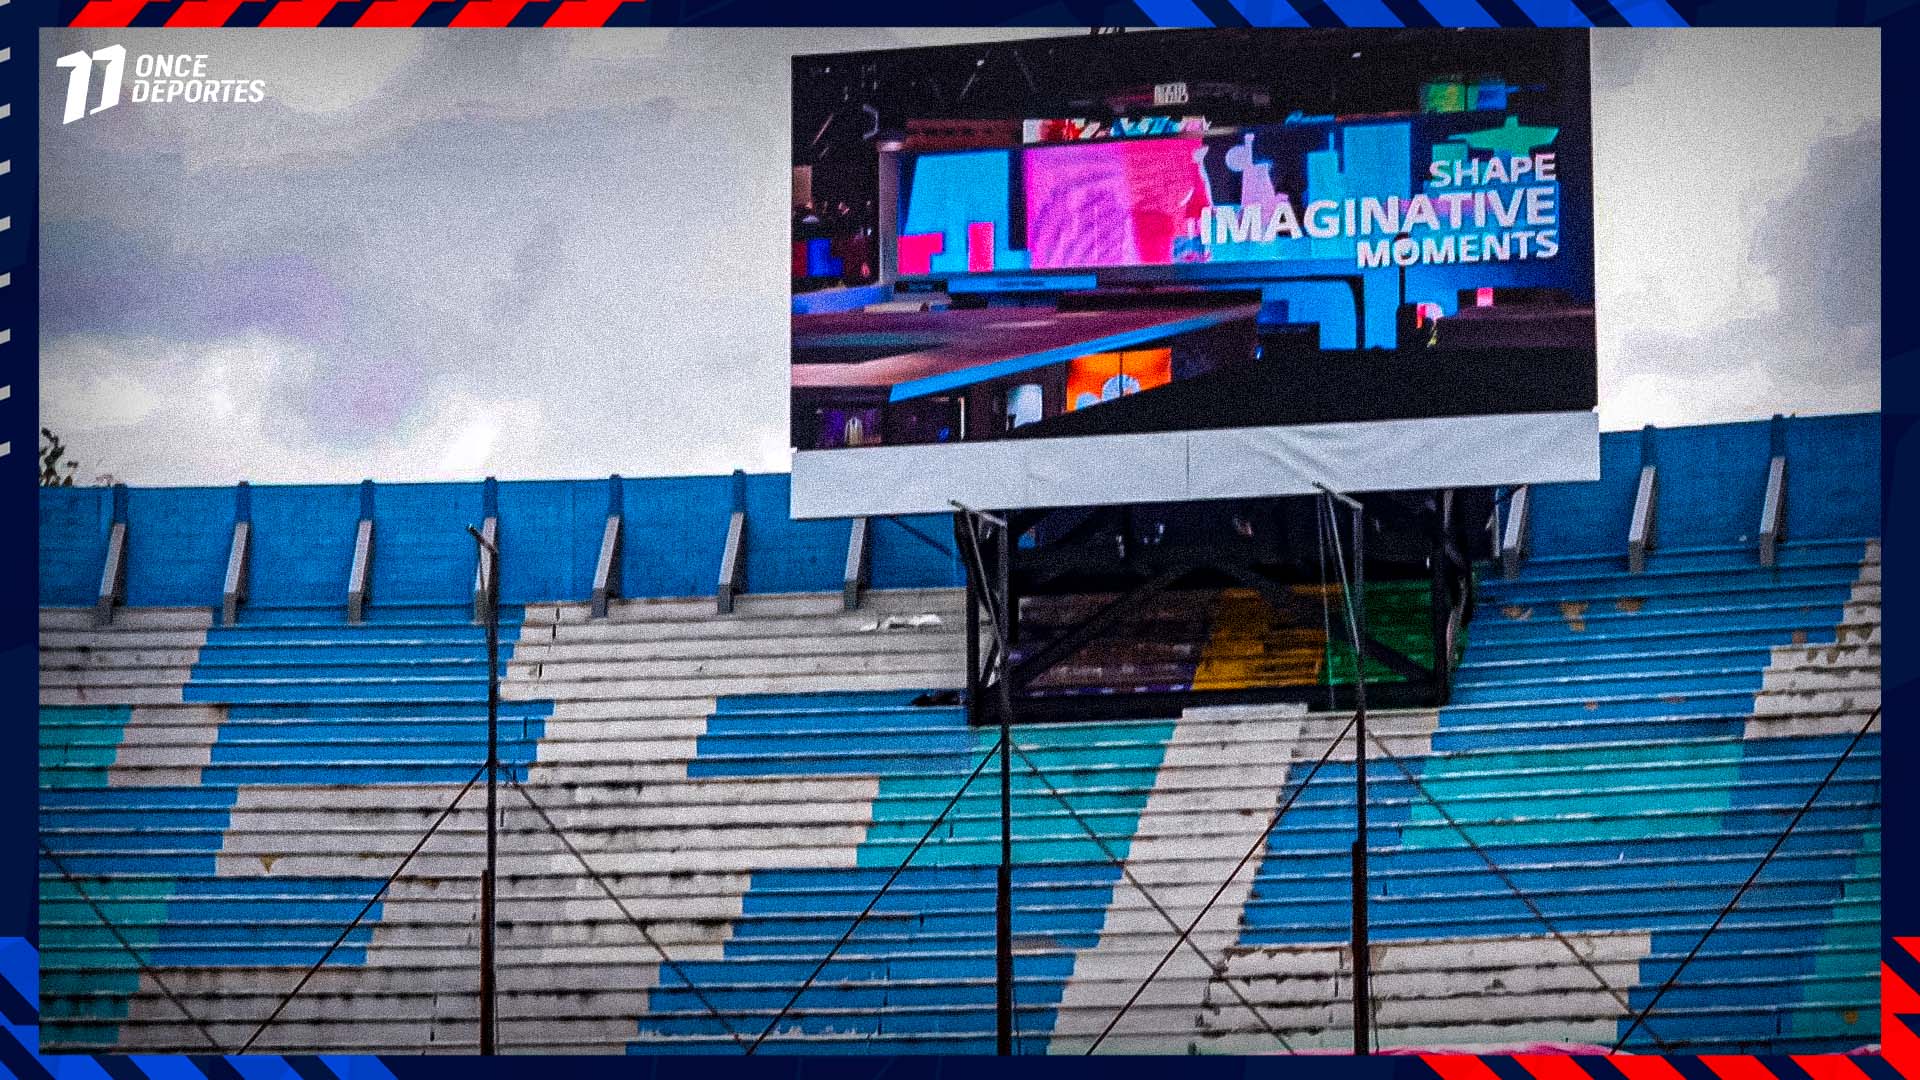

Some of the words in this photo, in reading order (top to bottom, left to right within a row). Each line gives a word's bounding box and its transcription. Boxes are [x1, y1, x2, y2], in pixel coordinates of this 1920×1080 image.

[1429, 153, 1557, 188] SHAPE
[1200, 186, 1556, 245] IMAGINATIVE
[1356, 230, 1559, 269] MOMENTS
